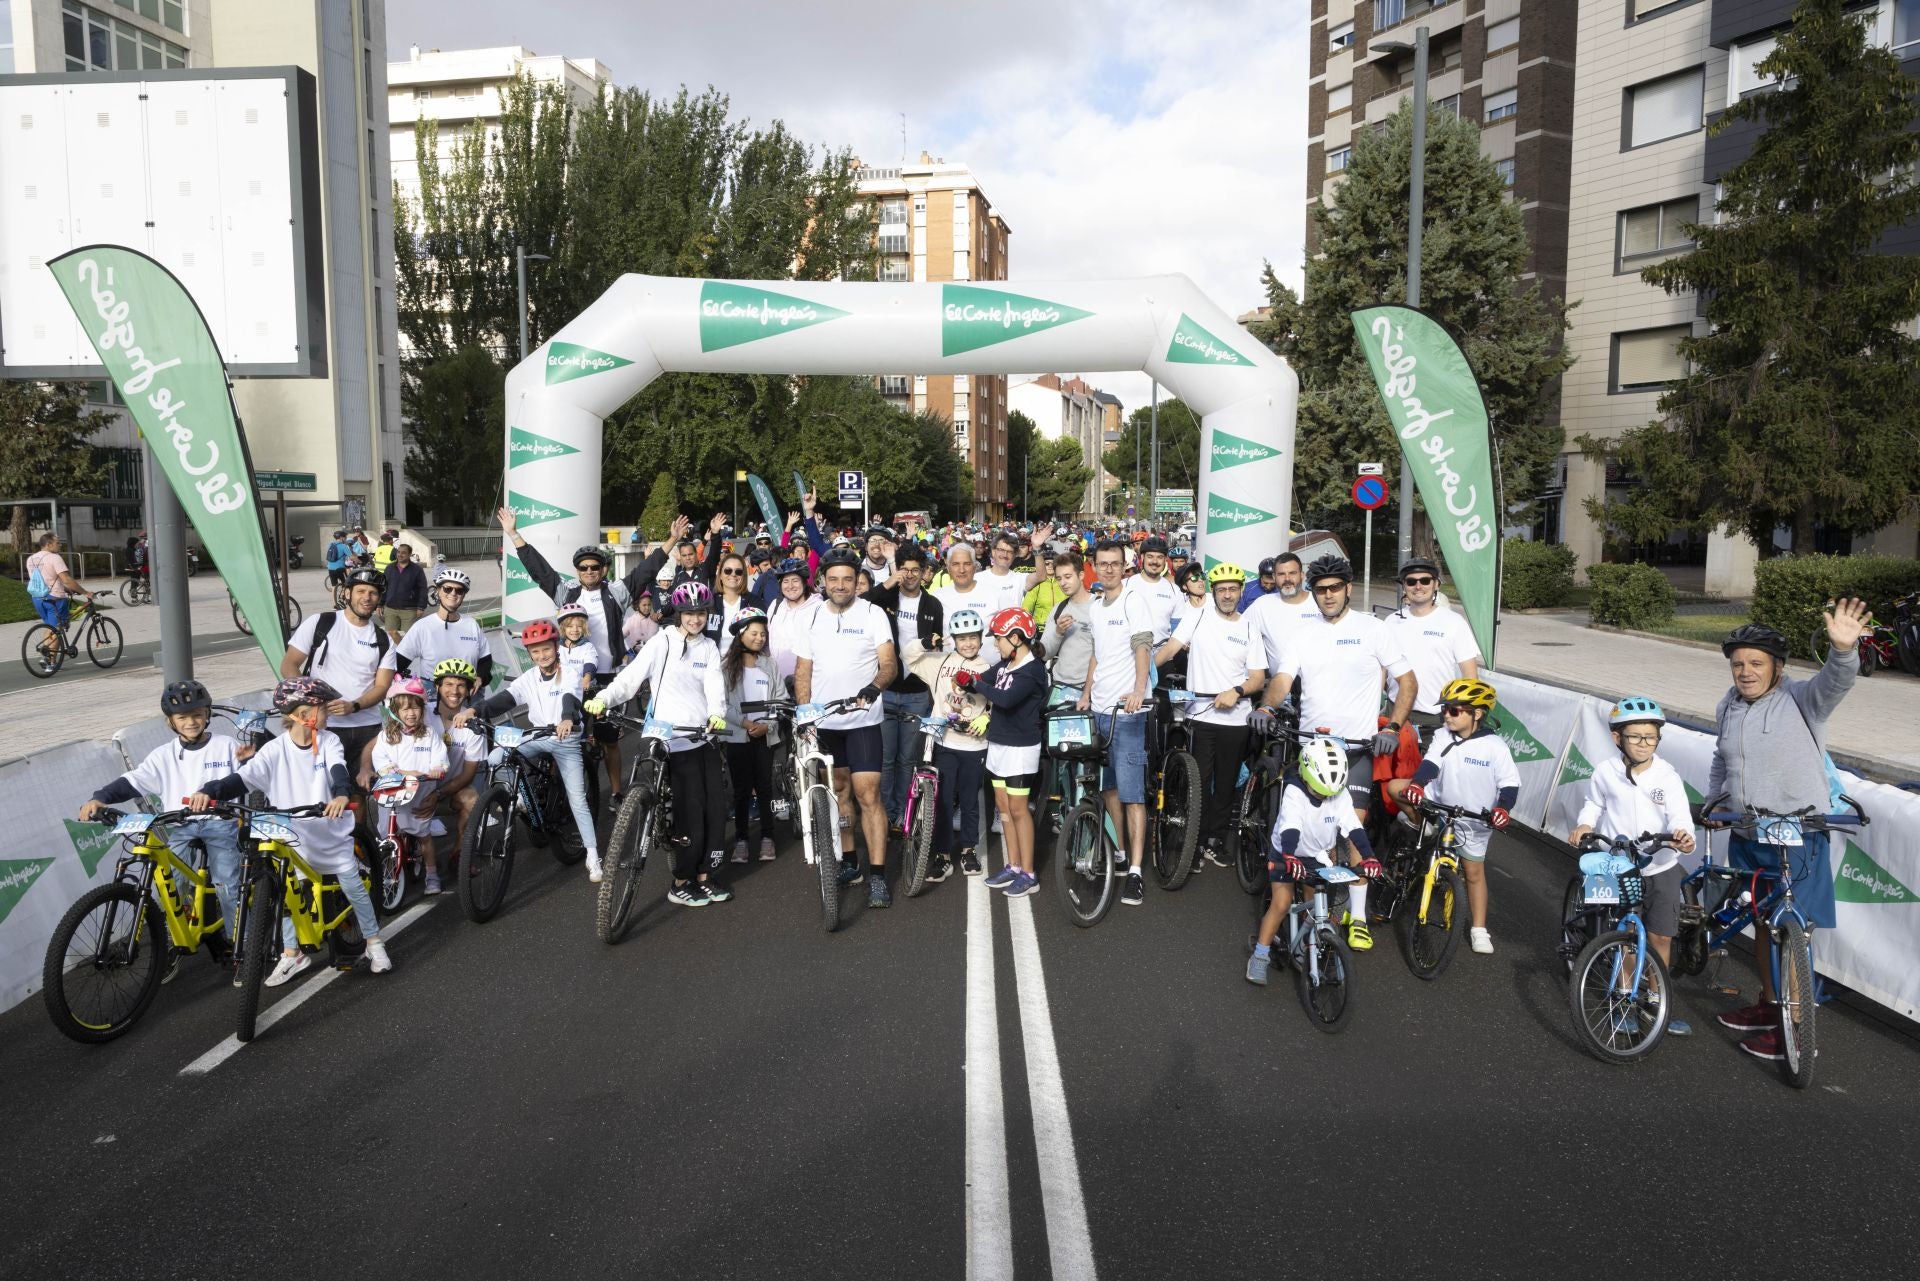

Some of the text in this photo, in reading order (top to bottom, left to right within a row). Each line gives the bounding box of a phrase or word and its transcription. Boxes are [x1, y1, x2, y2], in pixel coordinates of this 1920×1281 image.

[703, 298, 817, 325] El Corte Inglés
[945, 301, 1060, 327] El Corte Inglés
[1175, 332, 1239, 363] El Corte Inglés
[548, 352, 615, 370] El Corte Inglés
[516, 442, 533, 452] Corte
[1213, 443, 1269, 459] El Corte Inglés
[257, 479, 312, 489] Miguel Ángel Blanco
[844, 473, 858, 489] P
[514, 505, 530, 516] Corte
[530, 504, 561, 520] Inglés
[1208, 507, 1263, 523] El Corte Inglés
[896, 610, 917, 621] MAH
[1423, 630, 1445, 638] MAHLE
[1228, 636, 1248, 647] MAHLE
[1336, 638, 1361, 646] MAHLE
[497, 733, 519, 744] 1517
[1063, 728, 1081, 737] 966
[204, 760, 231, 770] MAHLE
[1464, 756, 1491, 767] MAHLE
[254, 824, 288, 835] 1516
[9, 861, 41, 889] Inglés
[1841, 863, 1905, 900] El Corte Inglés
[1592, 886, 1613, 899] 160
